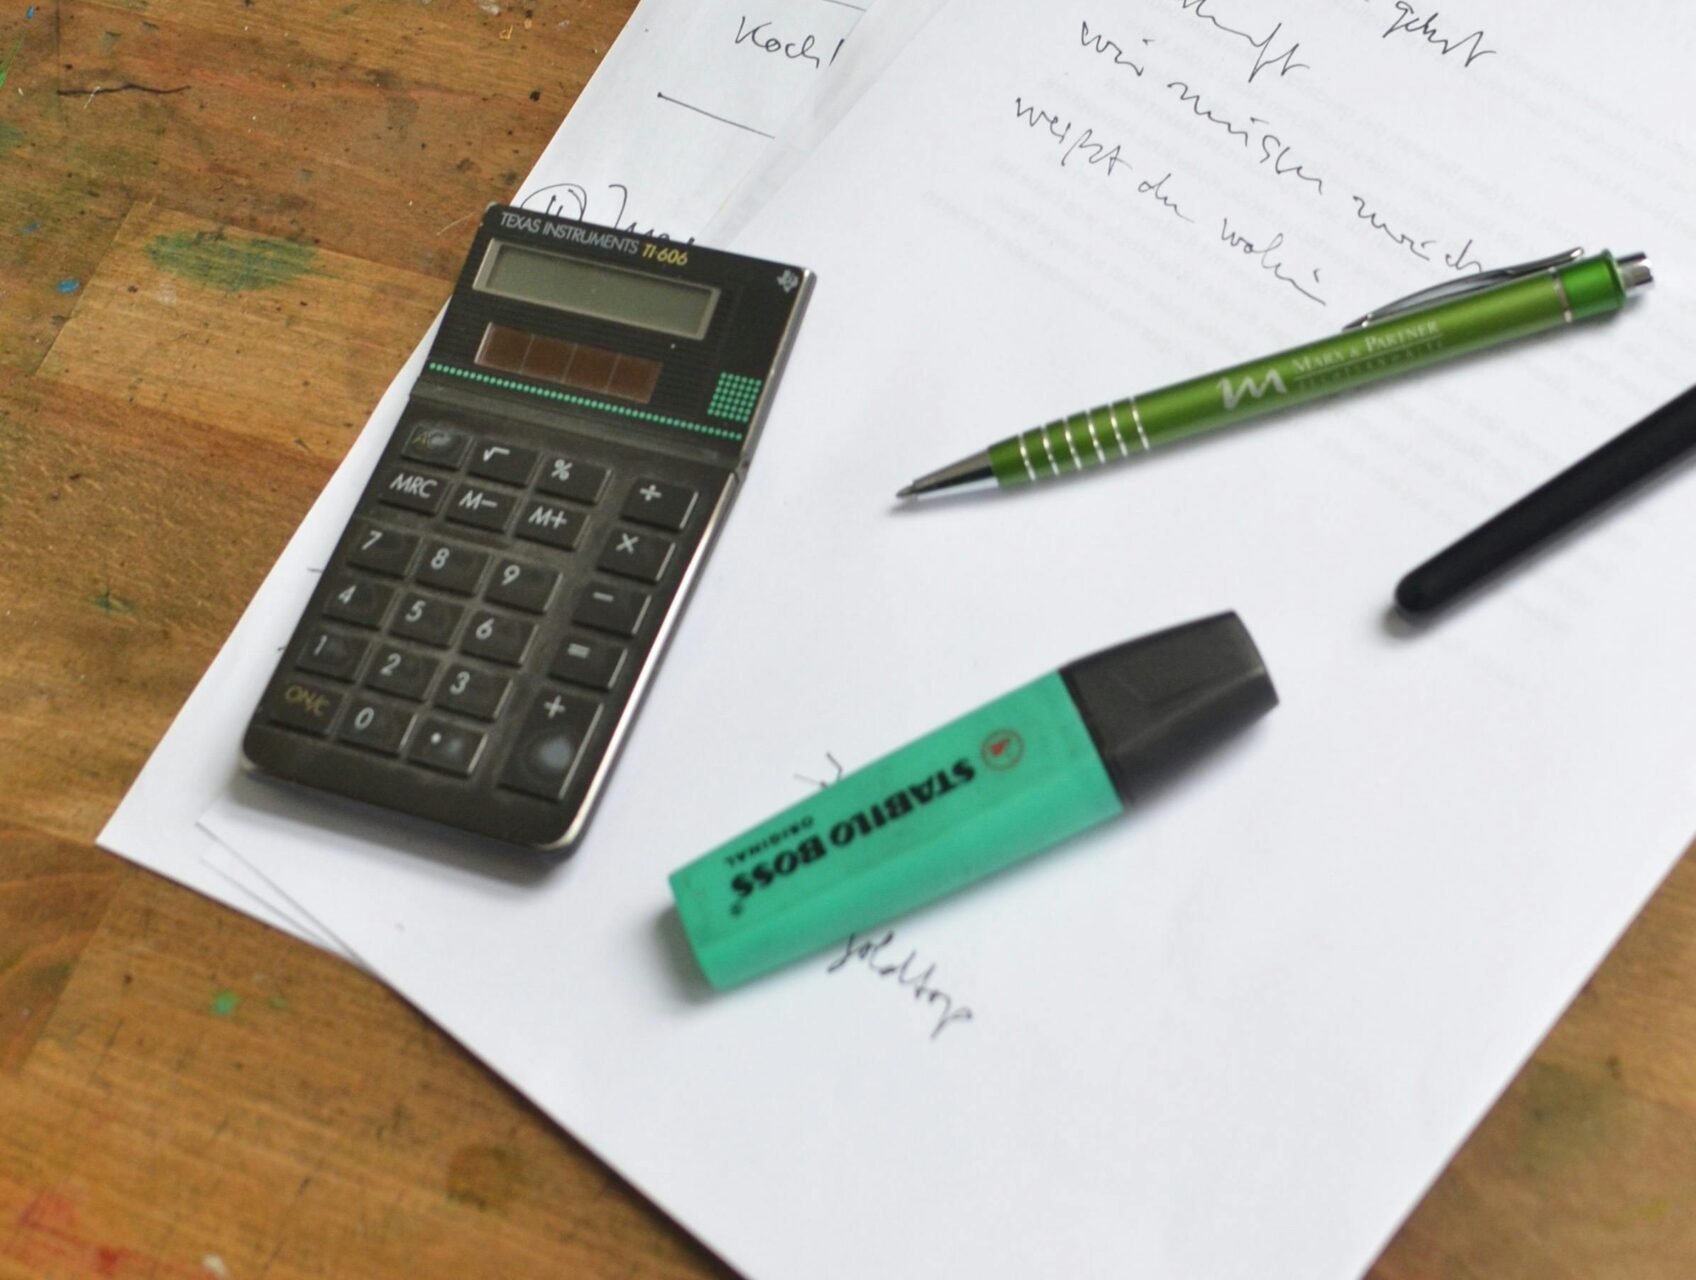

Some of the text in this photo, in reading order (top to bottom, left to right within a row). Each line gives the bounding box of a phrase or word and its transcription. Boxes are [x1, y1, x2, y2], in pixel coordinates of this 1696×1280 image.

[1138, 173, 1196, 224] du
[501, 211, 541, 233] TEXAS
[542, 221, 639, 254] INSTRUMENTS
[552, 459, 572, 480] %
[390, 474, 437, 498] MRC
[529, 507, 566, 528] M+
[362, 531, 382, 549] 7
[431, 548, 449, 569] 8
[503, 565, 520, 585] 9
[339, 586, 356, 603] 4
[406, 601, 425, 621] 5
[476, 619, 493, 639] 6
[381, 654, 401, 675] 2
[450, 672, 470, 694] 3
[355, 707, 374, 729] 0
[829, 758, 976, 848] STABILO
[725, 815, 814, 867] ORIGINAL
